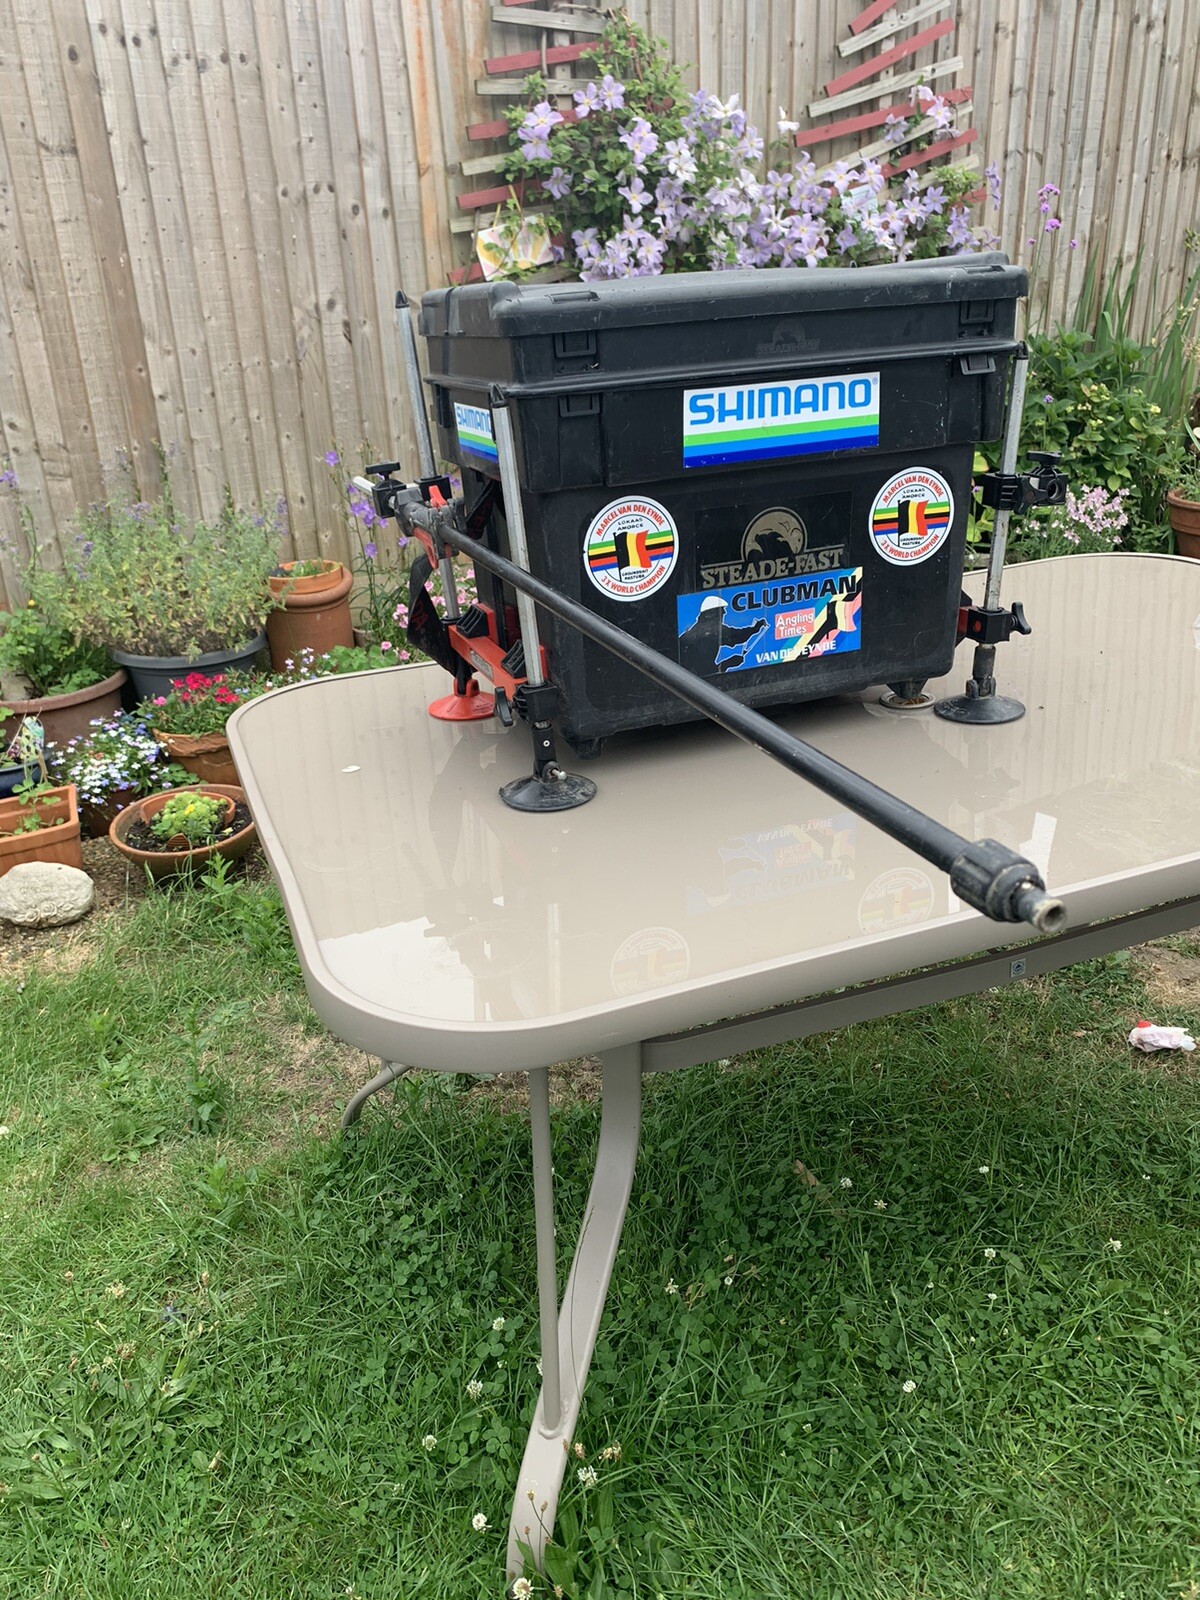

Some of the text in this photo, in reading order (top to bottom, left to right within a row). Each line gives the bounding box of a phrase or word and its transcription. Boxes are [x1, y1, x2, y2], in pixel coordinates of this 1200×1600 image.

[689, 378, 872, 425] SHIMANO
[883, 475, 944, 503] MARCEL VAN DEN EYNDE
[596, 504, 665, 536] MARCEL VAN DEN EYNDE
[889, 547, 910, 558] WORLD
[910, 534, 939, 558] CHAMPION
[611, 582, 634, 593] WORLD
[635, 565, 666, 593] CHAMPION
[702, 549, 843, 589] STEADE-FAST
[731, 575, 857, 612] CLUBMAN
[776, 611, 815, 628] Angling
[778, 626, 807, 638] Times
[755, 650, 779, 664] VAN
[802, 640, 836, 656] EYNDE
